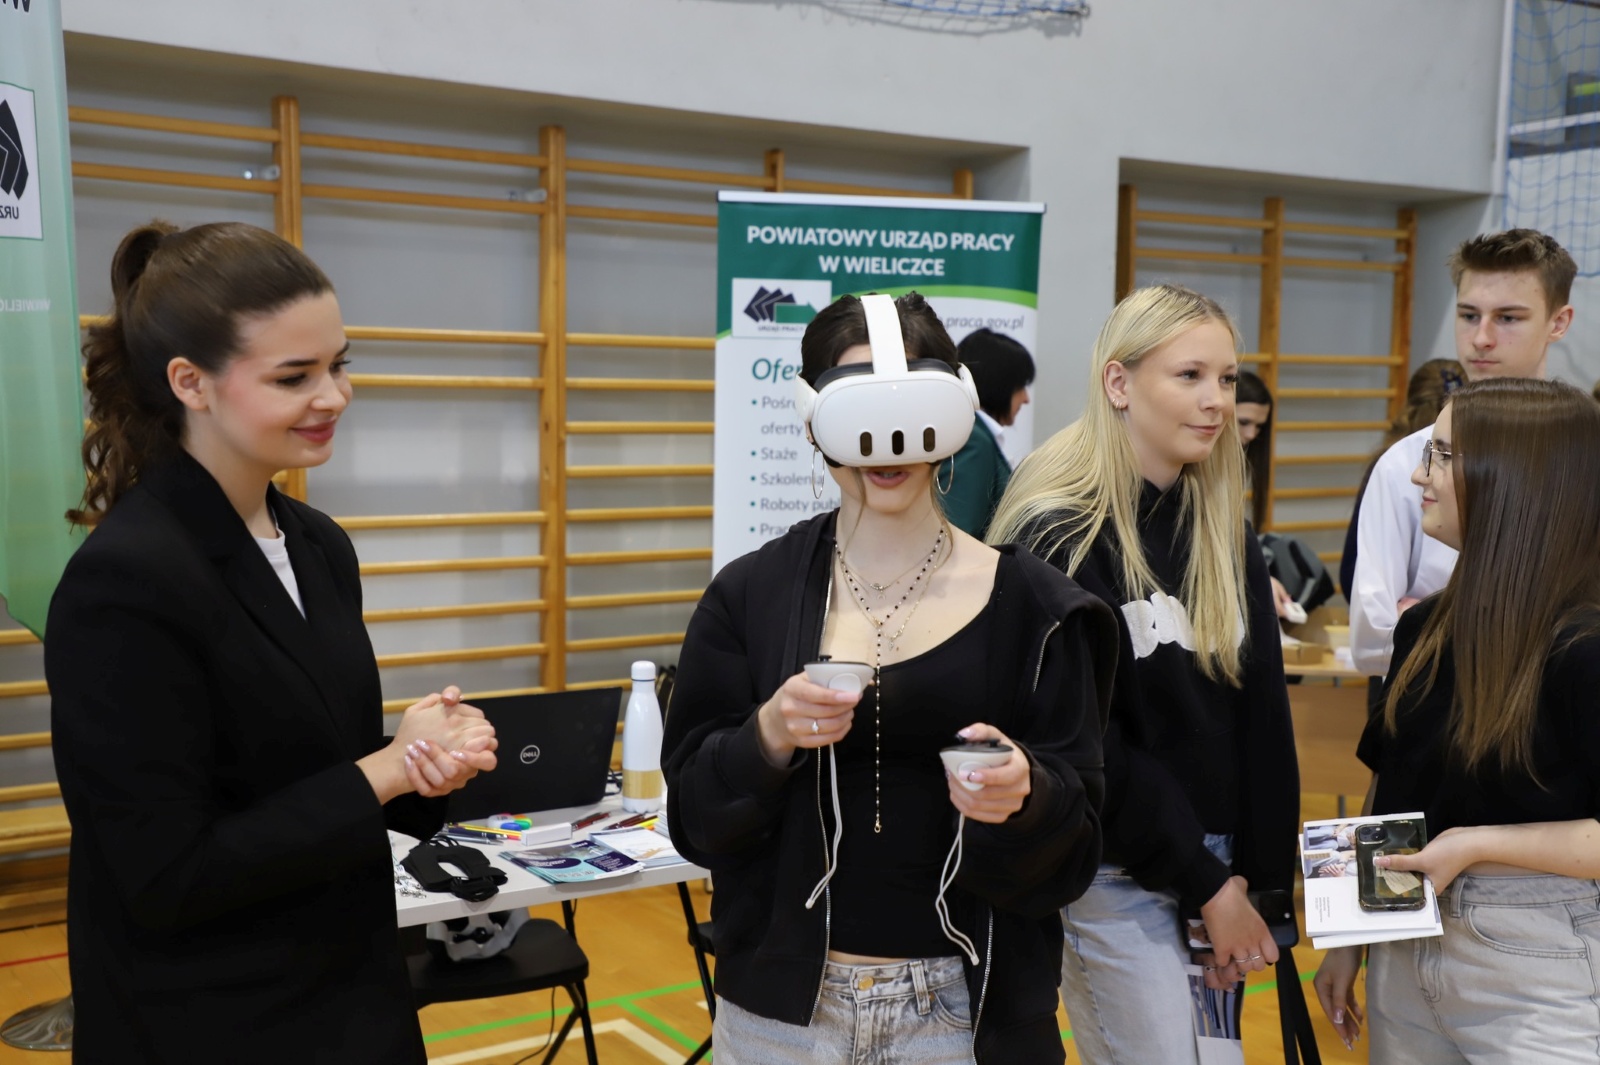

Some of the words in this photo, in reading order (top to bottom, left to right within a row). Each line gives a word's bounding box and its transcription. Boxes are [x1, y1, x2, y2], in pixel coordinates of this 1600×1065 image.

[747, 225, 877, 247] POWIATOWY
[880, 230, 948, 252] URZĄD
[950, 232, 1015, 251] PRACY
[818, 255, 840, 273] W
[843, 256, 945, 276] WIELICZCE
[761, 422, 802, 436] oferty
[761, 447, 797, 460] Staże
[760, 498, 808, 512] Roboty
